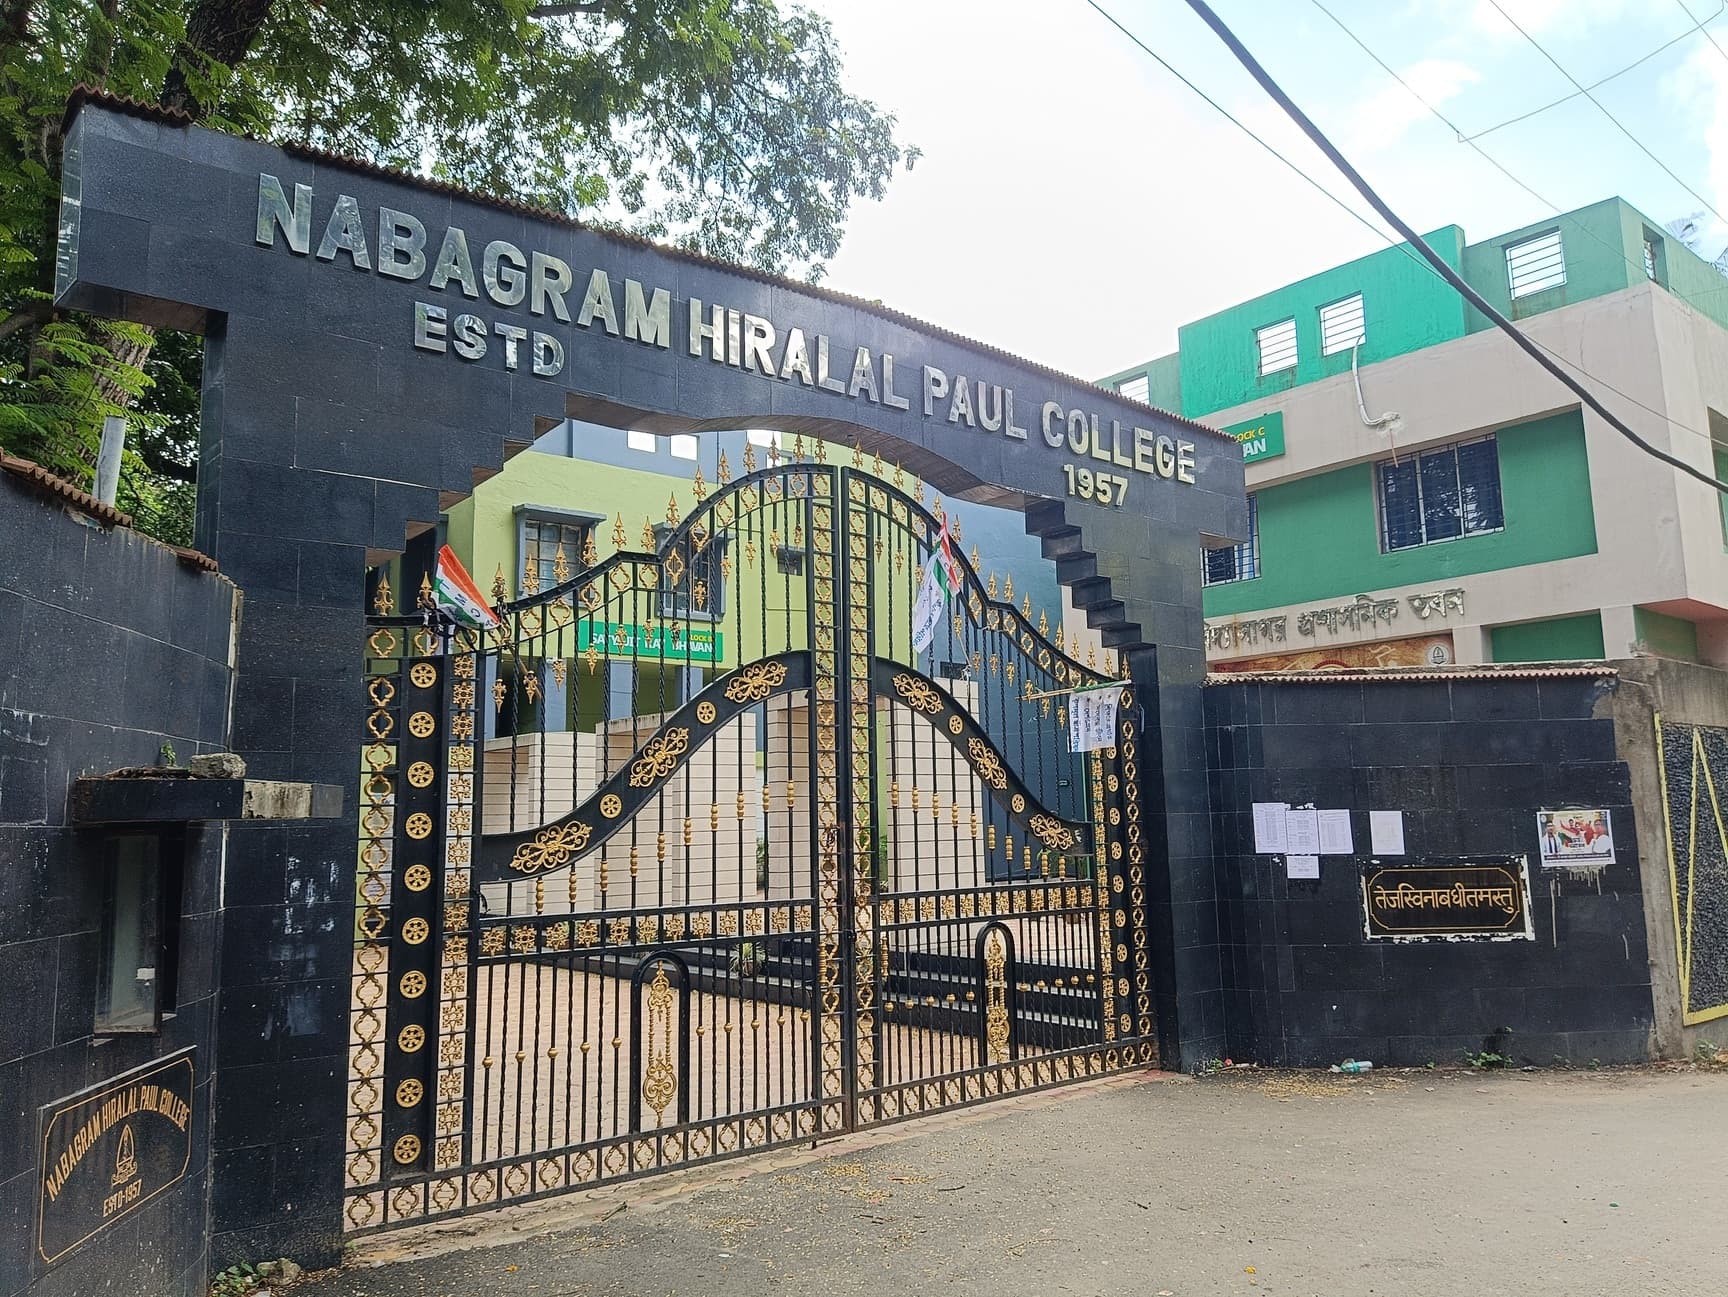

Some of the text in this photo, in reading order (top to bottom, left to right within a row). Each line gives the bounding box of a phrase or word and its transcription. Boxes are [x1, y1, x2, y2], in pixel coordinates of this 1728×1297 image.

[255, 172, 1196, 485] NABAGRAM HIRALAL PAUL COLLEGE
[414, 301, 1128, 508] ESTD 1957
[592, 633, 641, 647] SAYJIT
[644, 638, 665, 649] RA
[1407, 587, 1466, 619] ভবন
[46, 1085, 190, 1202] NABAGRAM HIRALAL PAUL COLLEGE
[103, 1179, 142, 1217] ESTD-1957
